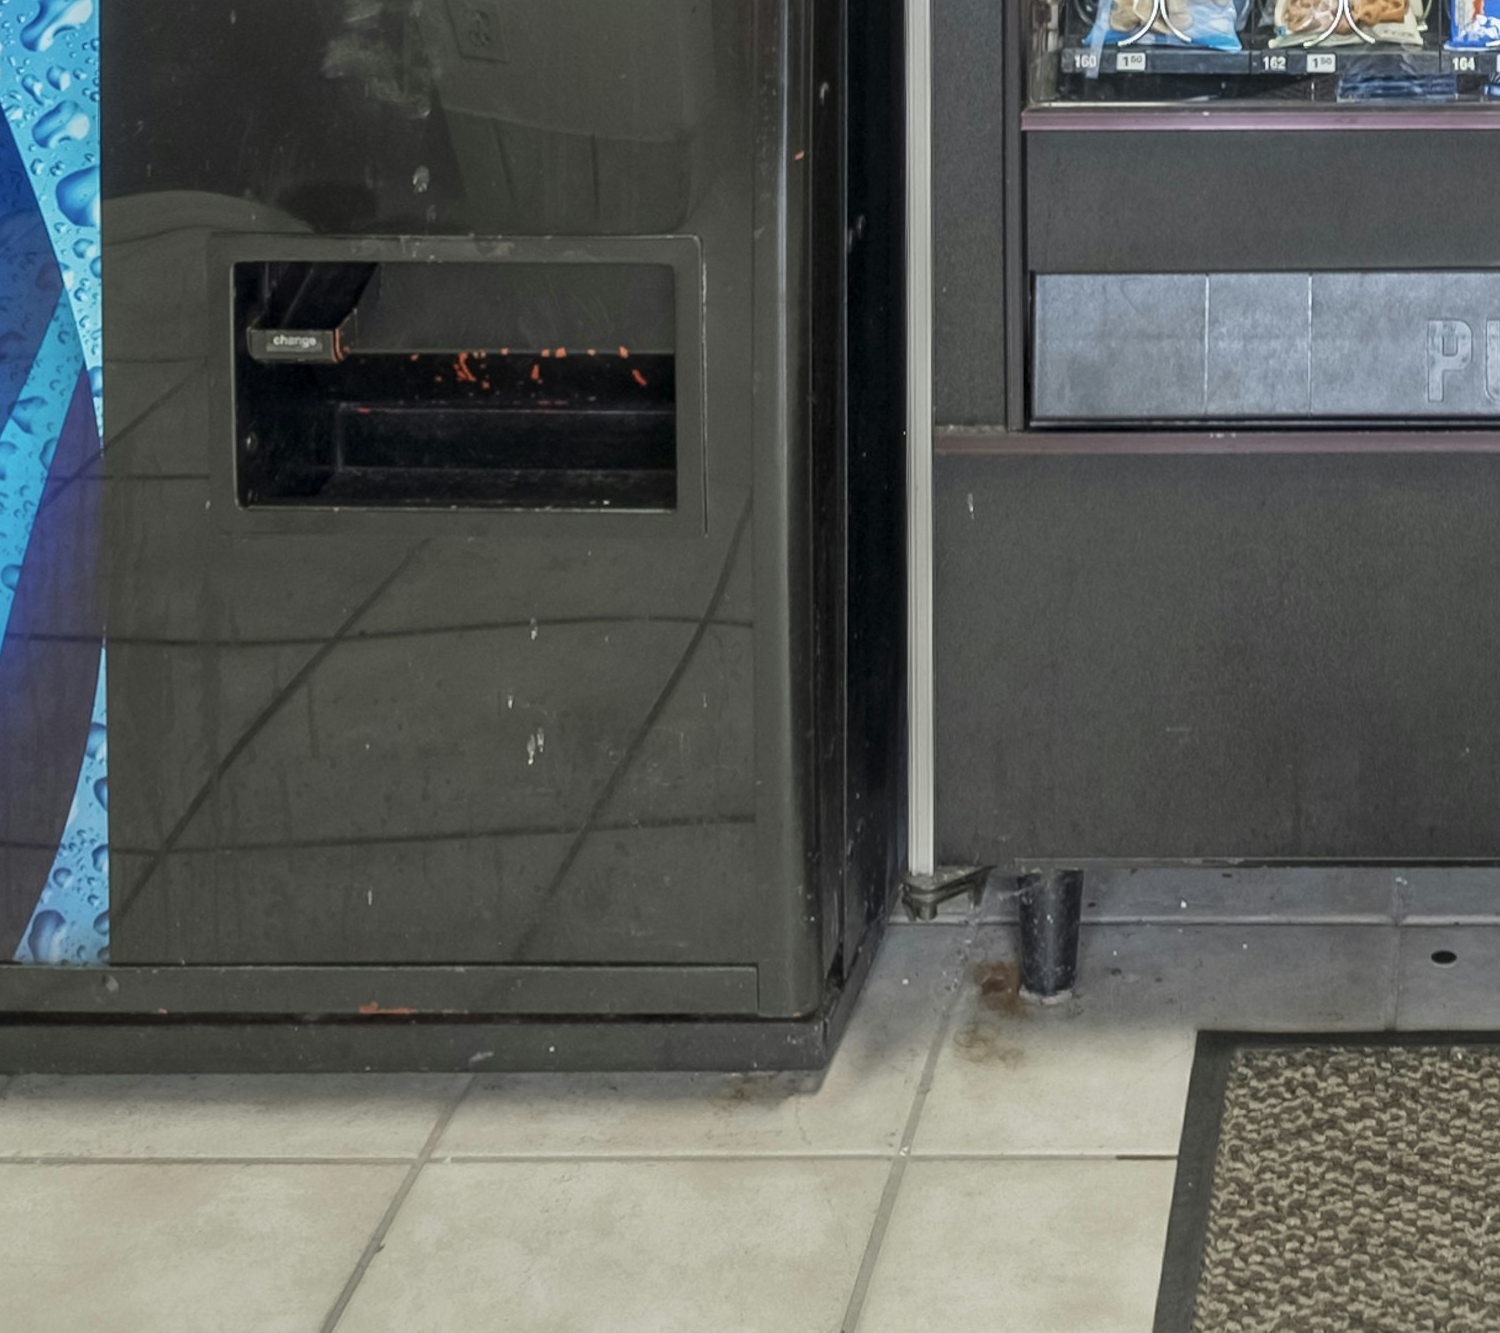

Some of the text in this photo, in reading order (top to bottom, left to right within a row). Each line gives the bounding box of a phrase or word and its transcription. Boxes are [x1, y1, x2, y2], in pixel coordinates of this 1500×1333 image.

[1073, 55, 1097, 70] 160
[1262, 55, 1287, 70] 162
[1452, 56, 1476, 71] 164
